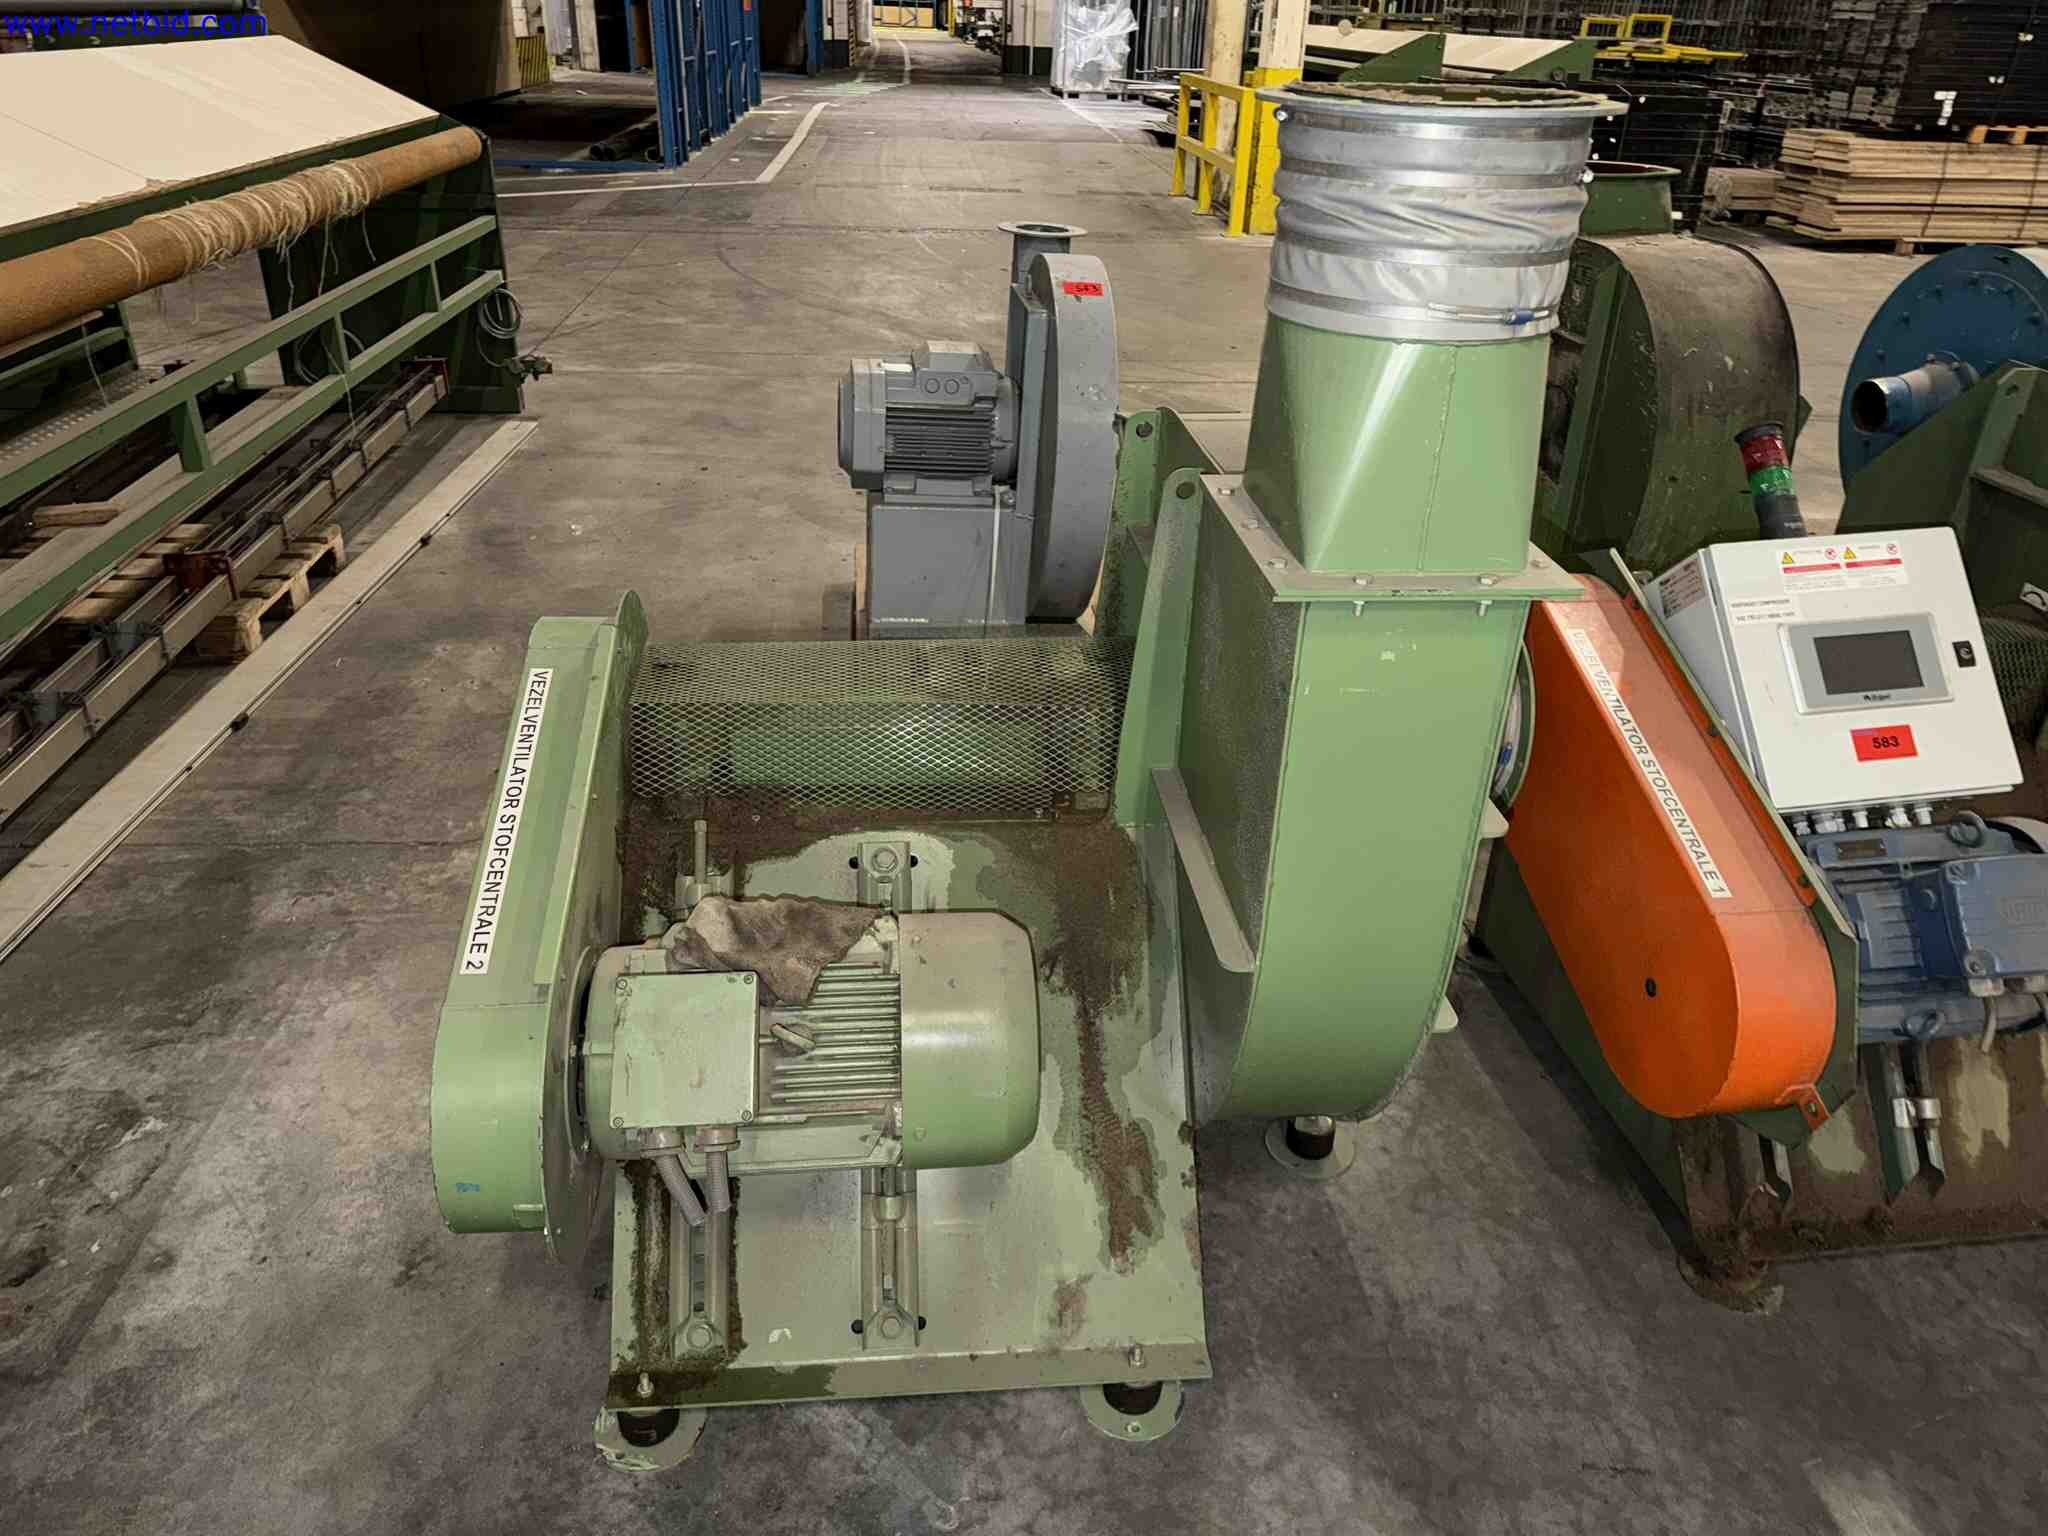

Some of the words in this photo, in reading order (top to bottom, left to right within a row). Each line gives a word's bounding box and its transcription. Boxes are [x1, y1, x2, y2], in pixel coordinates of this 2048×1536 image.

[503, 671, 549, 809] VEZELVENTILATOR
[1573, 632, 1649, 755] VELVENTILATOR
[1642, 759, 1720, 881] STOFCENTRALE
[1711, 885, 1726, 893] 1
[1872, 735, 1900, 749] 583
[470, 814, 517, 954] STOFCENTRALE
[465, 960, 484, 970] 2
